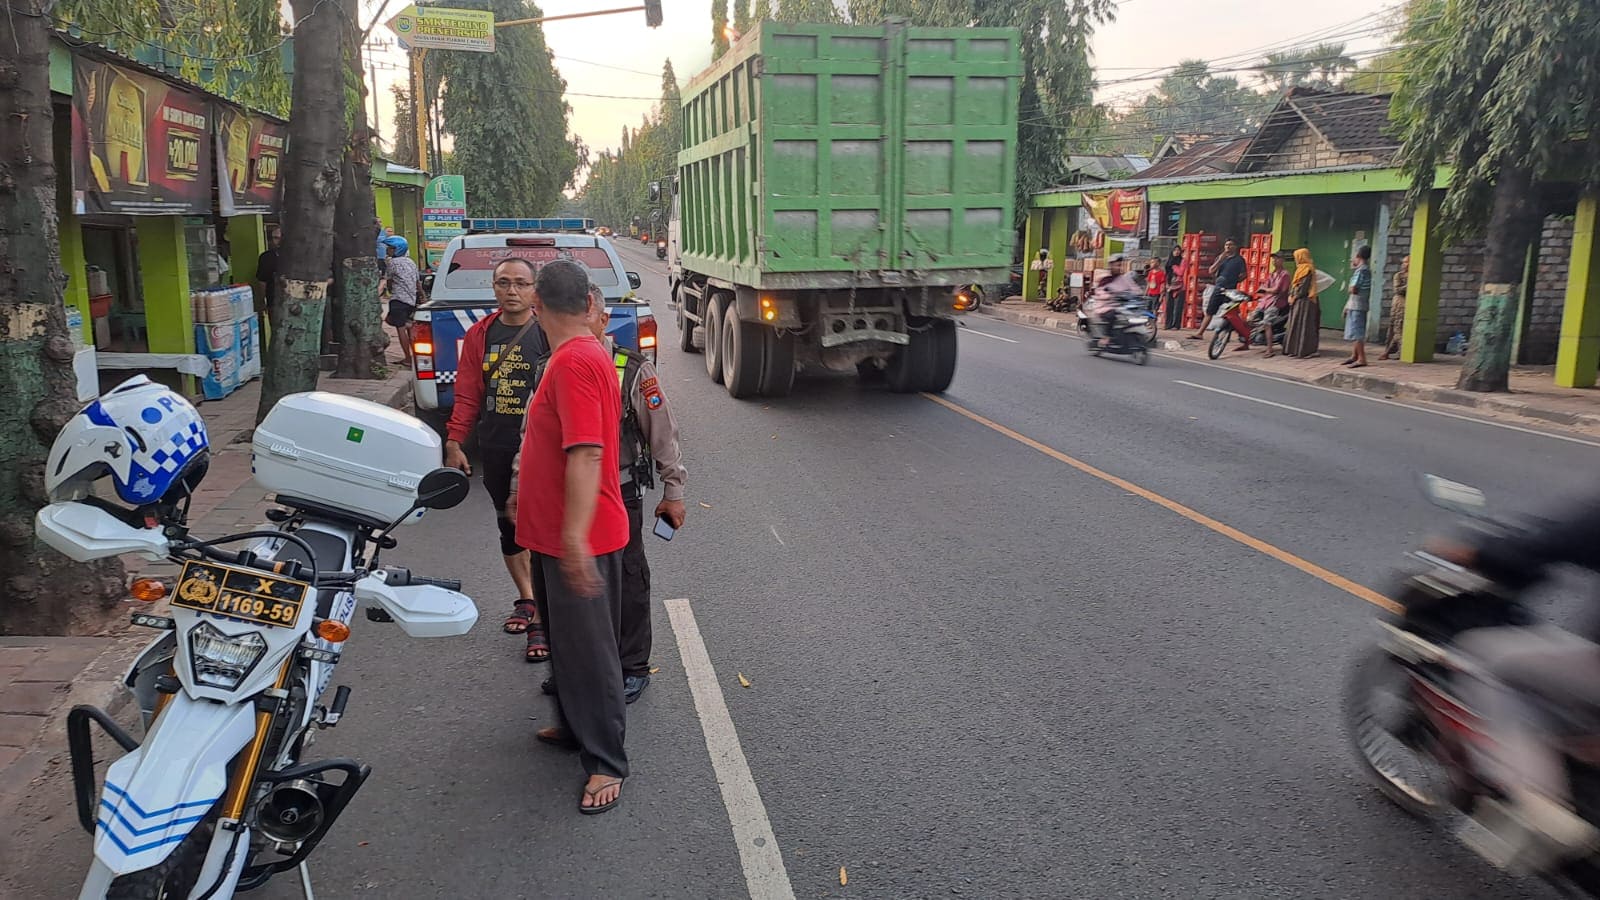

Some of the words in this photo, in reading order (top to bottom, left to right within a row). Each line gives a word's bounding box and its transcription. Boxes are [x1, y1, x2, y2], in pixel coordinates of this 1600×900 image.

[416, 17, 442, 26] SMK
[443, 19, 488, 31] TECHNO
[416, 26, 488, 39] PRENEURSHIP
[256, 578, 274, 594] X
[221, 594, 294, 622] 1169-59
